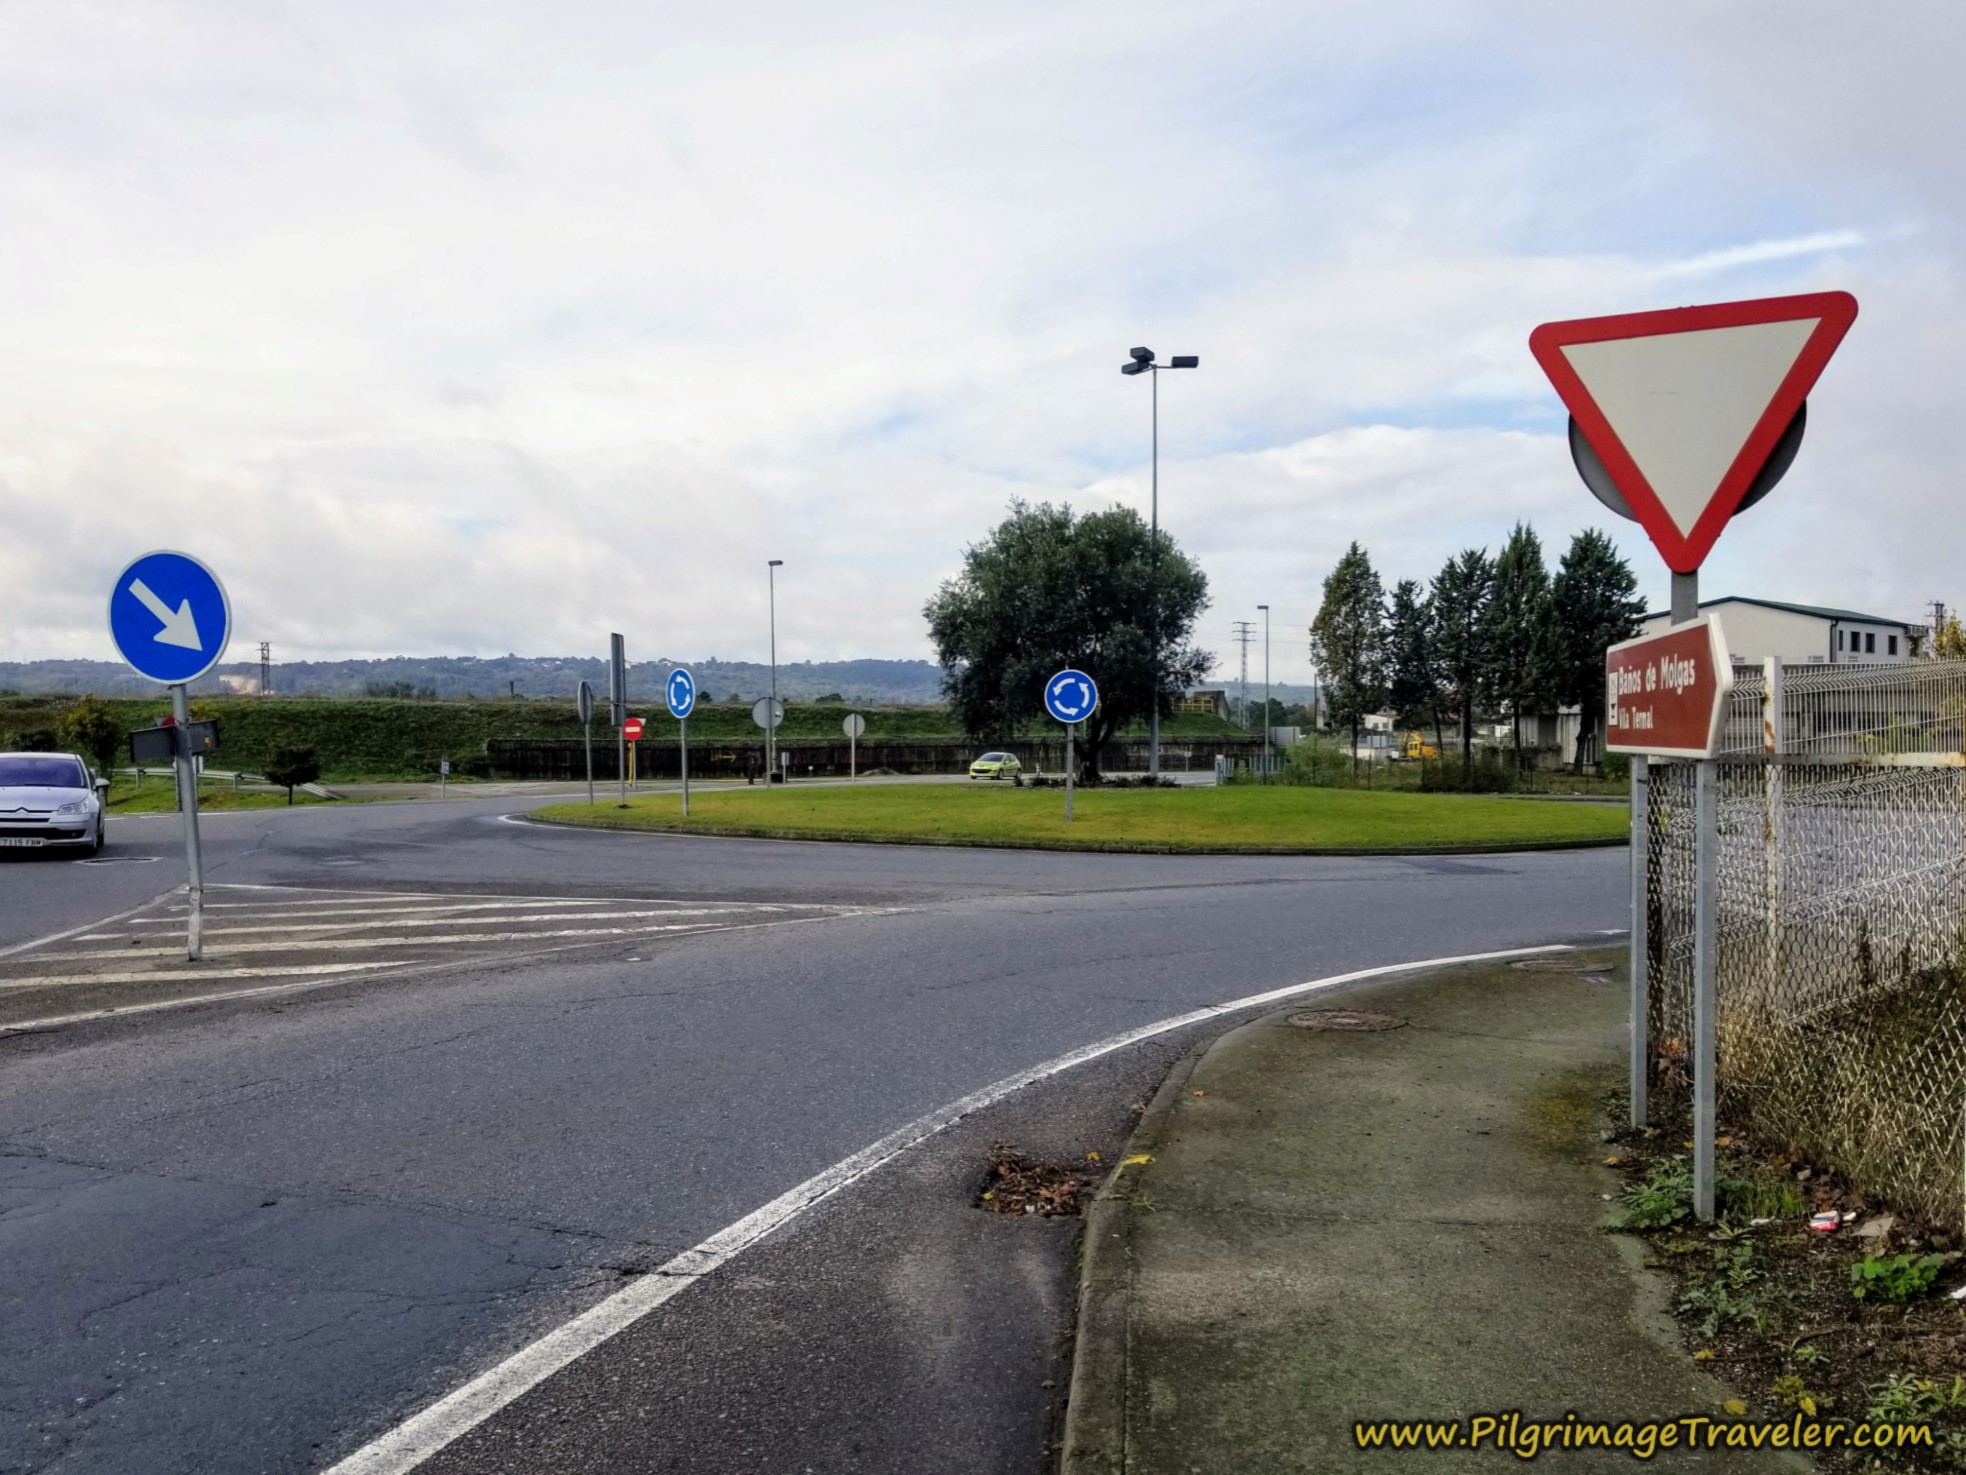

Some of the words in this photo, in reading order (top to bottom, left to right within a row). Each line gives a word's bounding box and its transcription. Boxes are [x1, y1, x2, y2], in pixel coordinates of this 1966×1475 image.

[1618, 665, 1642, 696] Baños
[1645, 661, 1657, 693] de
[1660, 653, 1696, 696] Molgas
[2, 838, 24, 847] 7115
